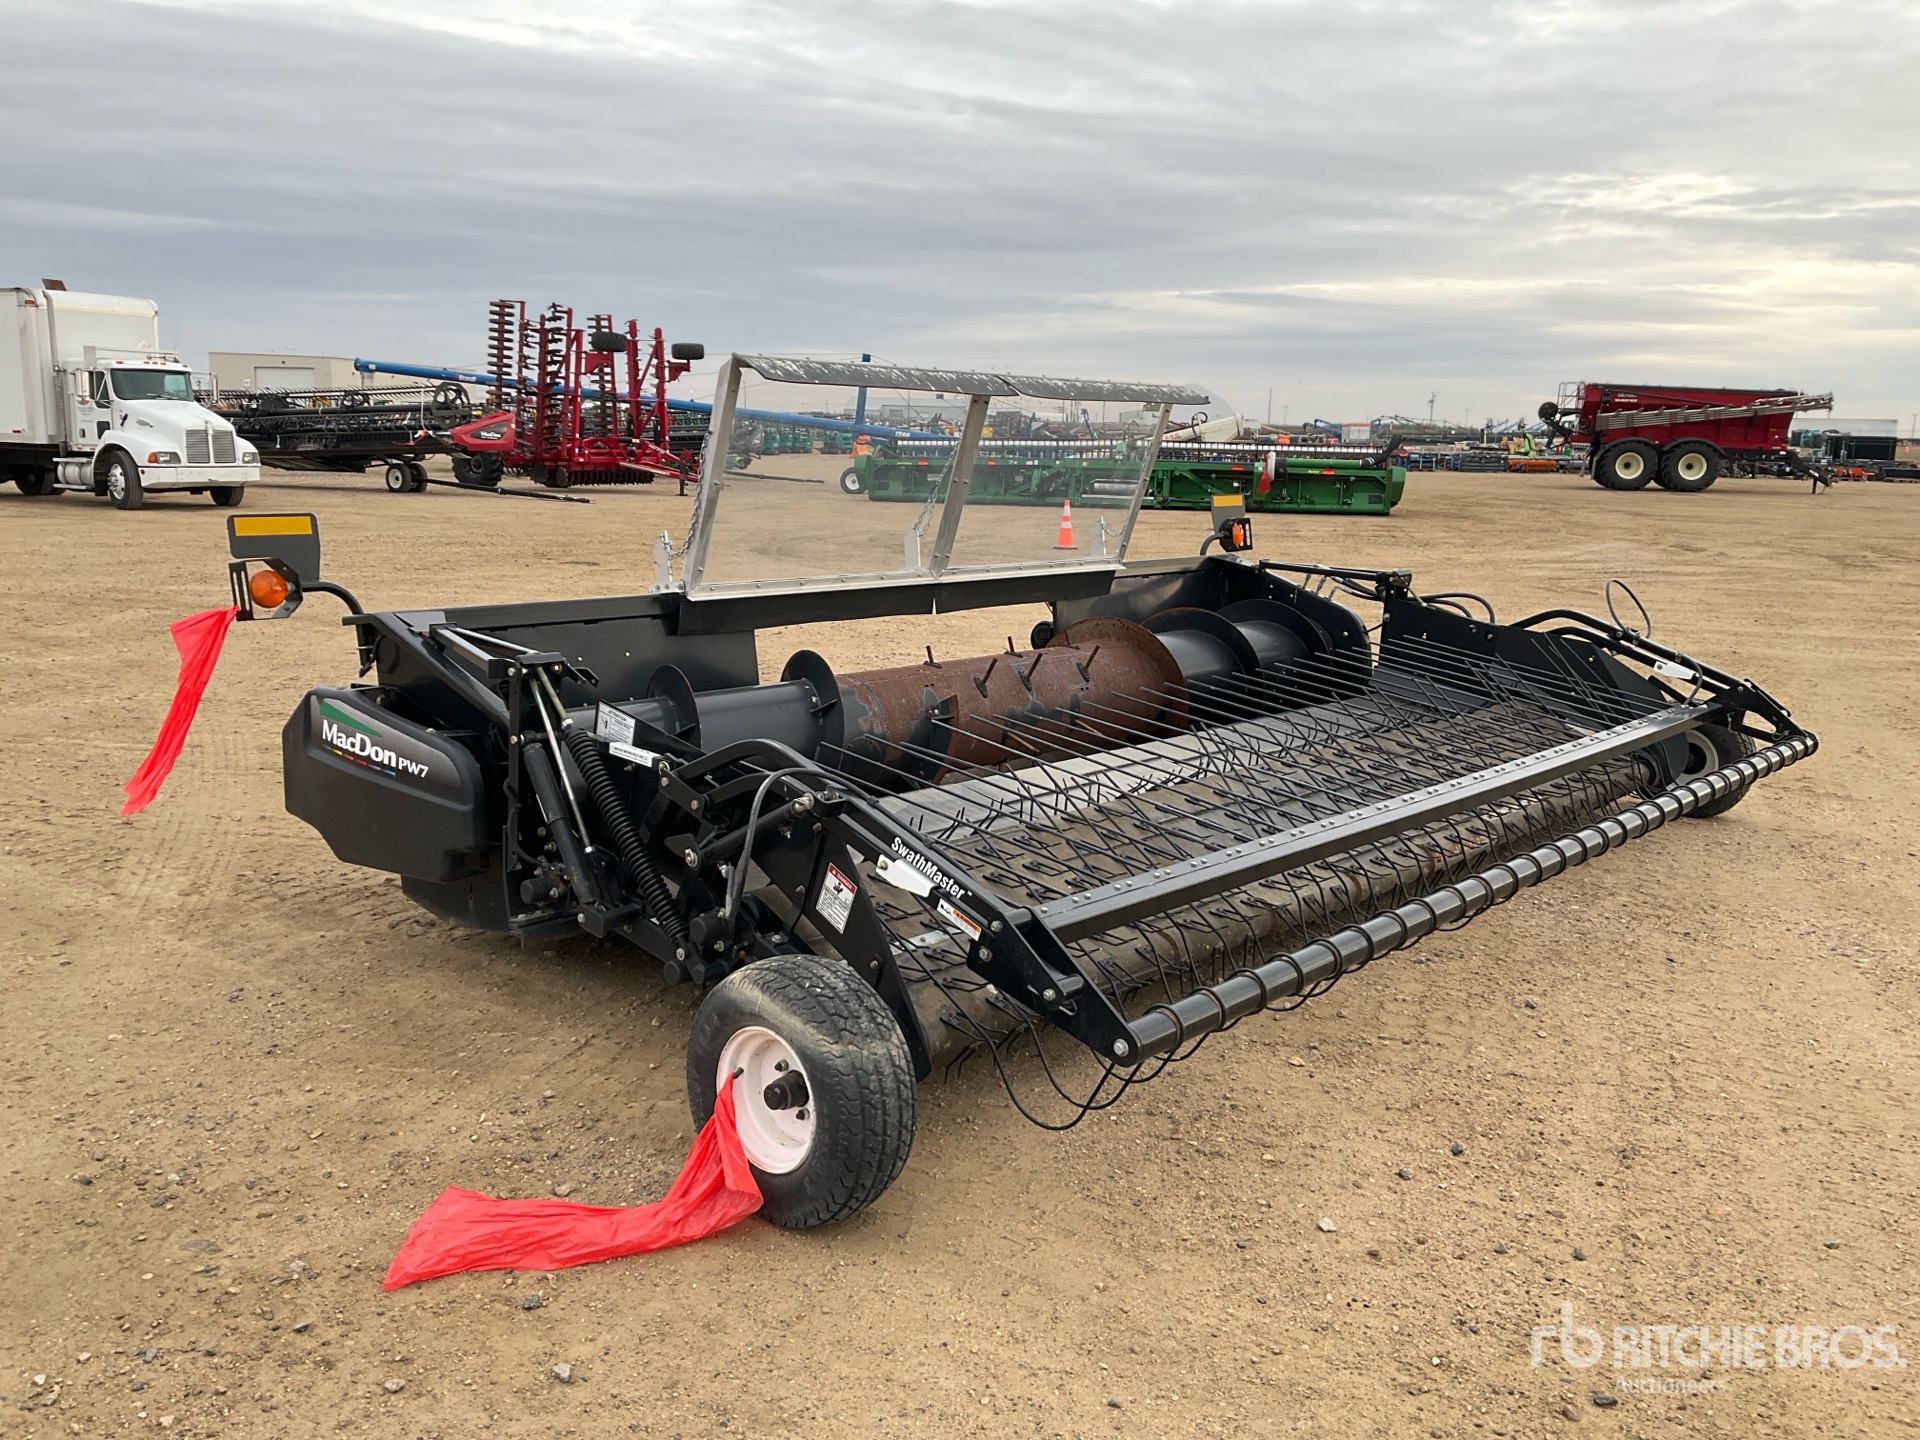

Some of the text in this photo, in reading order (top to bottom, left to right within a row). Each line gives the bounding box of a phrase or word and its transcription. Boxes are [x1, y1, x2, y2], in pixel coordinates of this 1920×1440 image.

[322, 719, 429, 778] MacDon PW7
[891, 836, 965, 899] SwathMaster
